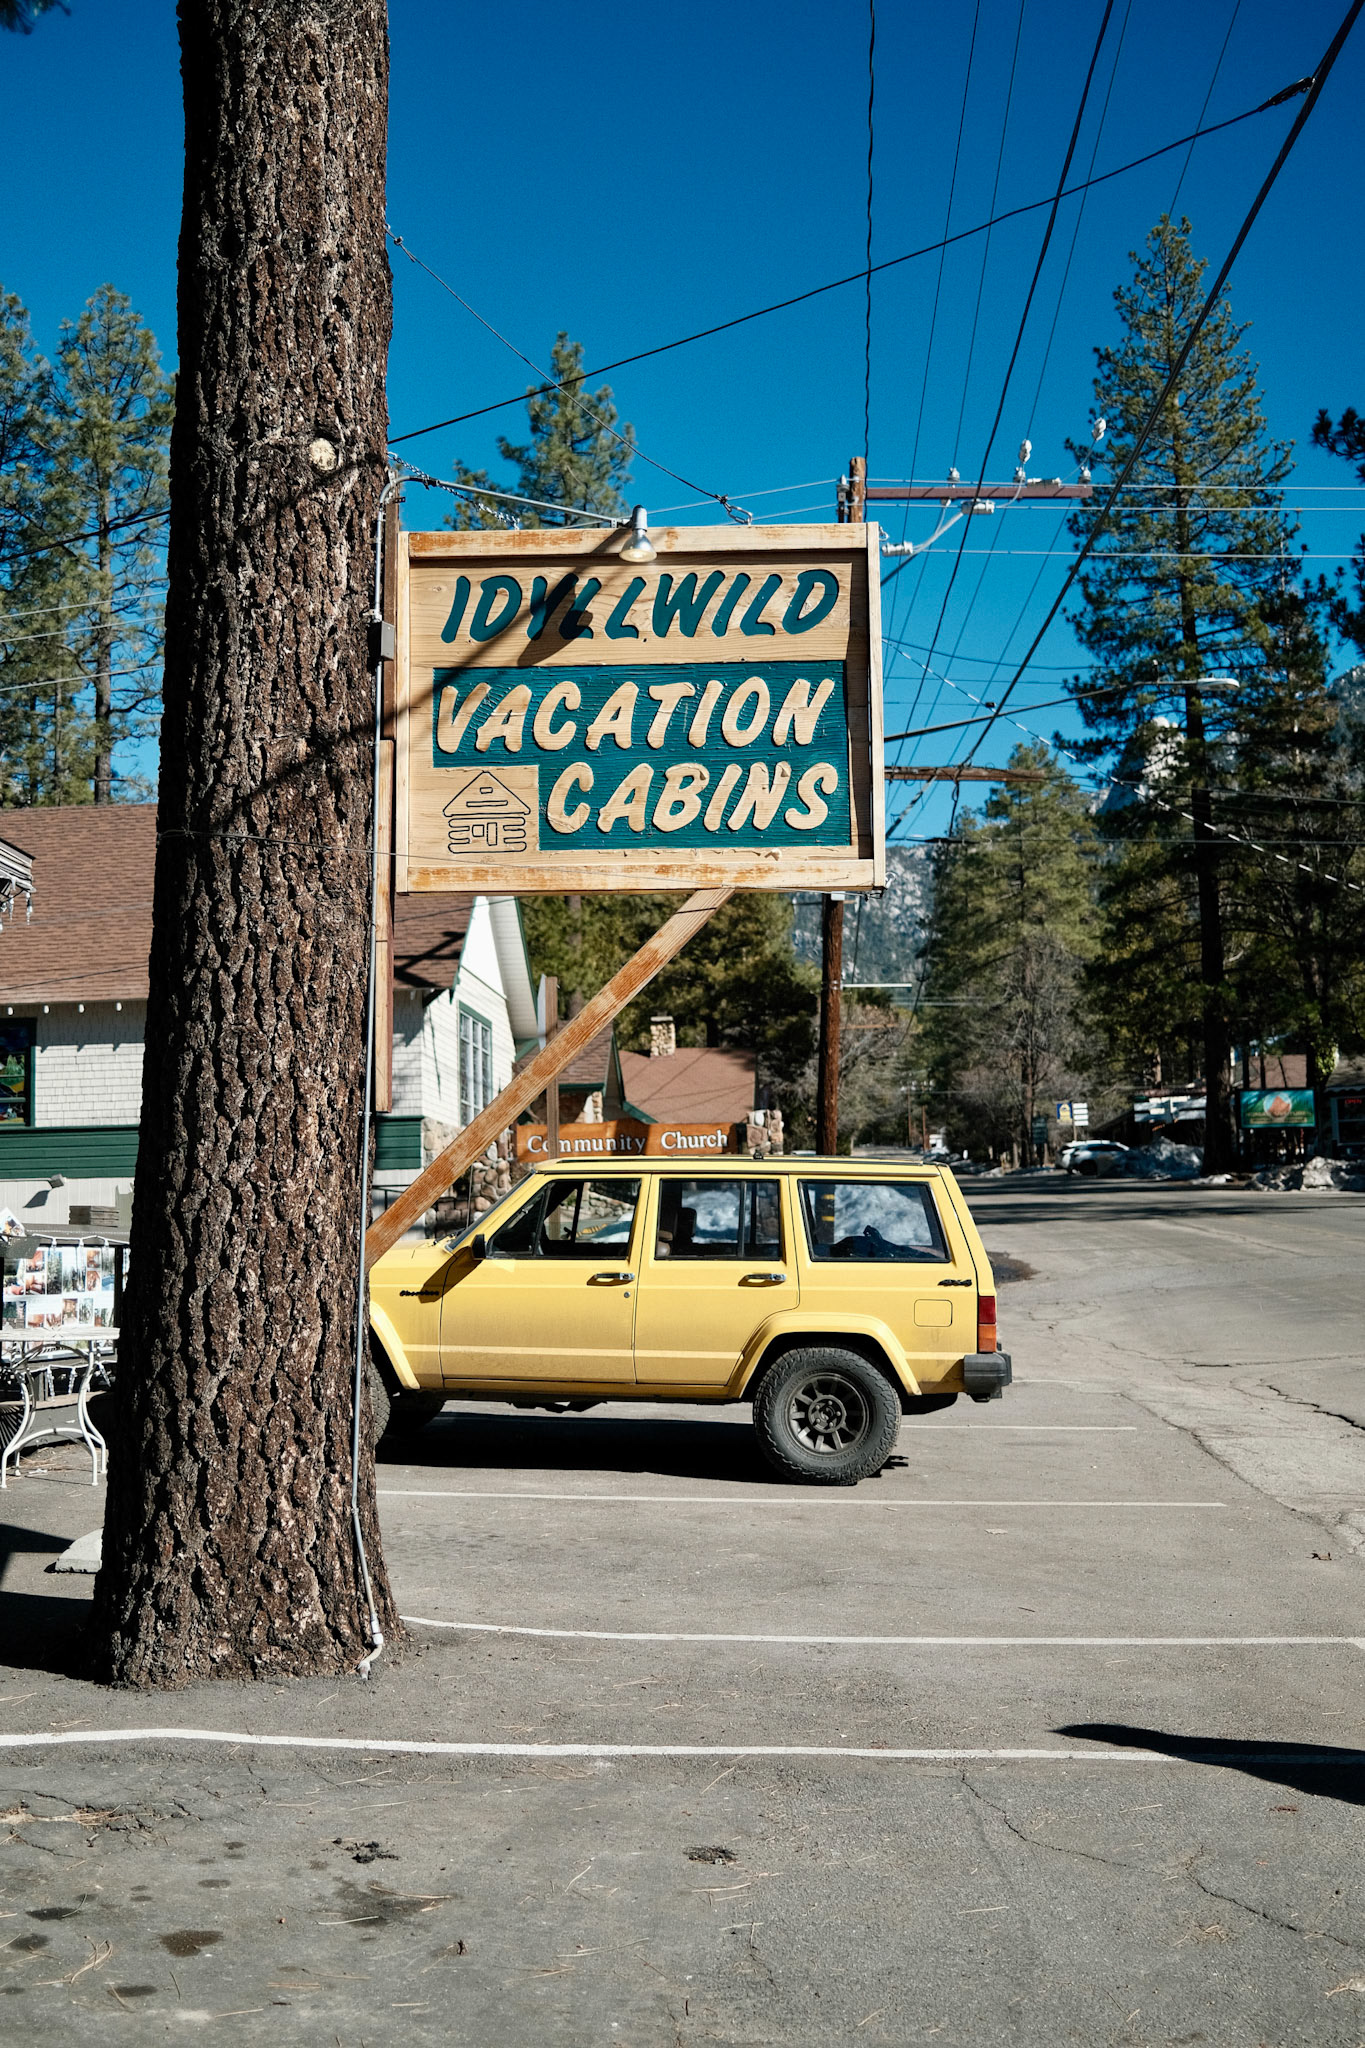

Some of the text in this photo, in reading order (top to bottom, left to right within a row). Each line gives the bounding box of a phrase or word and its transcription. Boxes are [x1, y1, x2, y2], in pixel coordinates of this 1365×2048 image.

[440, 569, 840, 643] IDYLLWILD
[437, 676, 835, 754] VACATION
[546, 761, 839, 834] CABINS
[660, 1129, 728, 1150] Church
